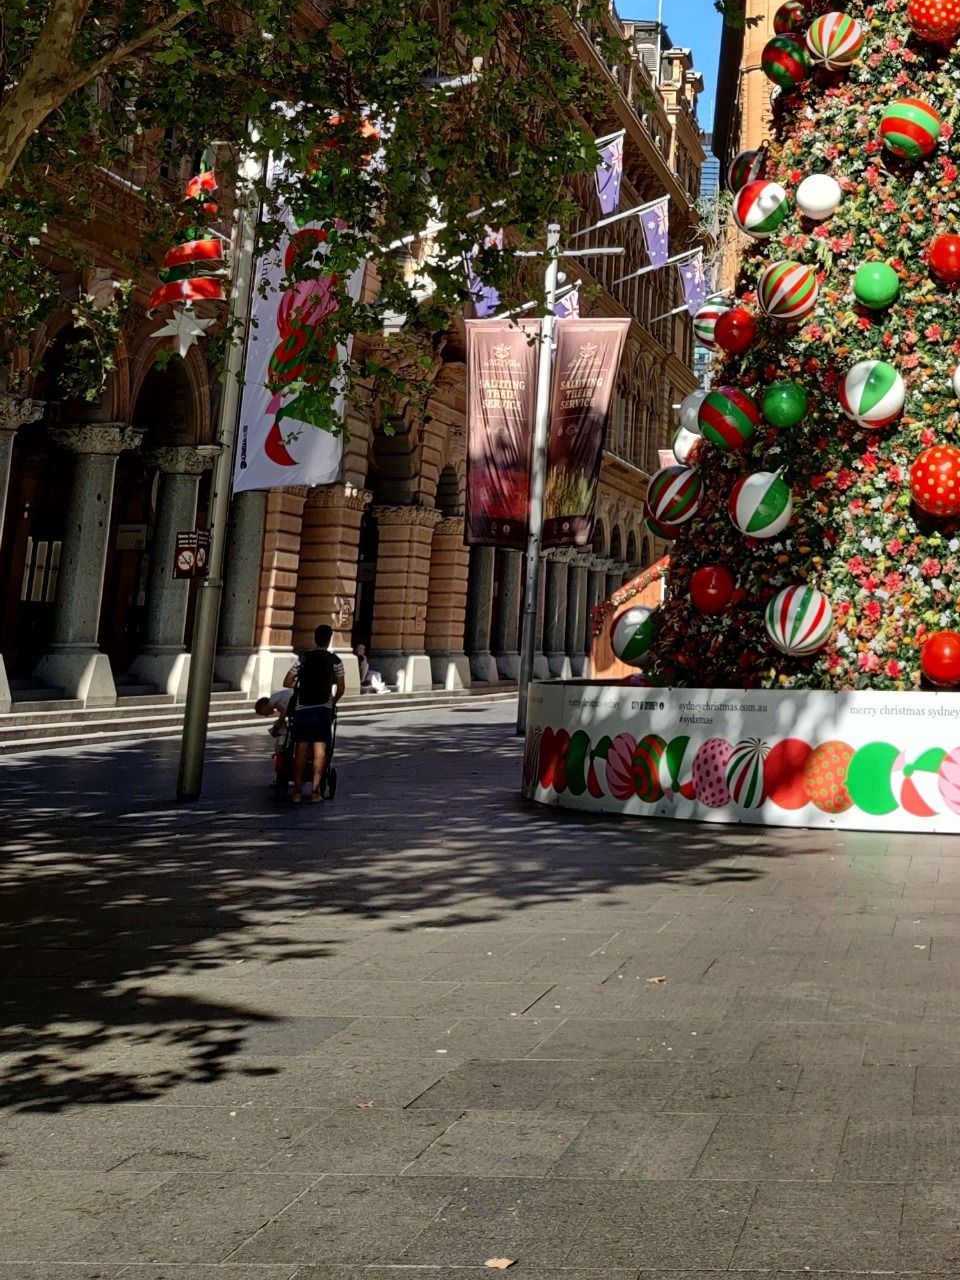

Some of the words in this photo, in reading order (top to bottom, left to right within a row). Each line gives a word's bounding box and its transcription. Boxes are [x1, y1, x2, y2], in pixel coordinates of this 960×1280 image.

[479, 379, 526, 391] SALUTING
[559, 377, 604, 390] SALUTING
[565, 388, 594, 399] THEIR
[559, 398, 596, 410] SERVICE
[679, 700, 768, 713] sydneychristmas.com.au
[849, 706, 877, 717] merry
[879, 704, 926, 715] christmas
[927, 705, 960, 719] sydney
[679, 714, 714, 726] #sydxmas
